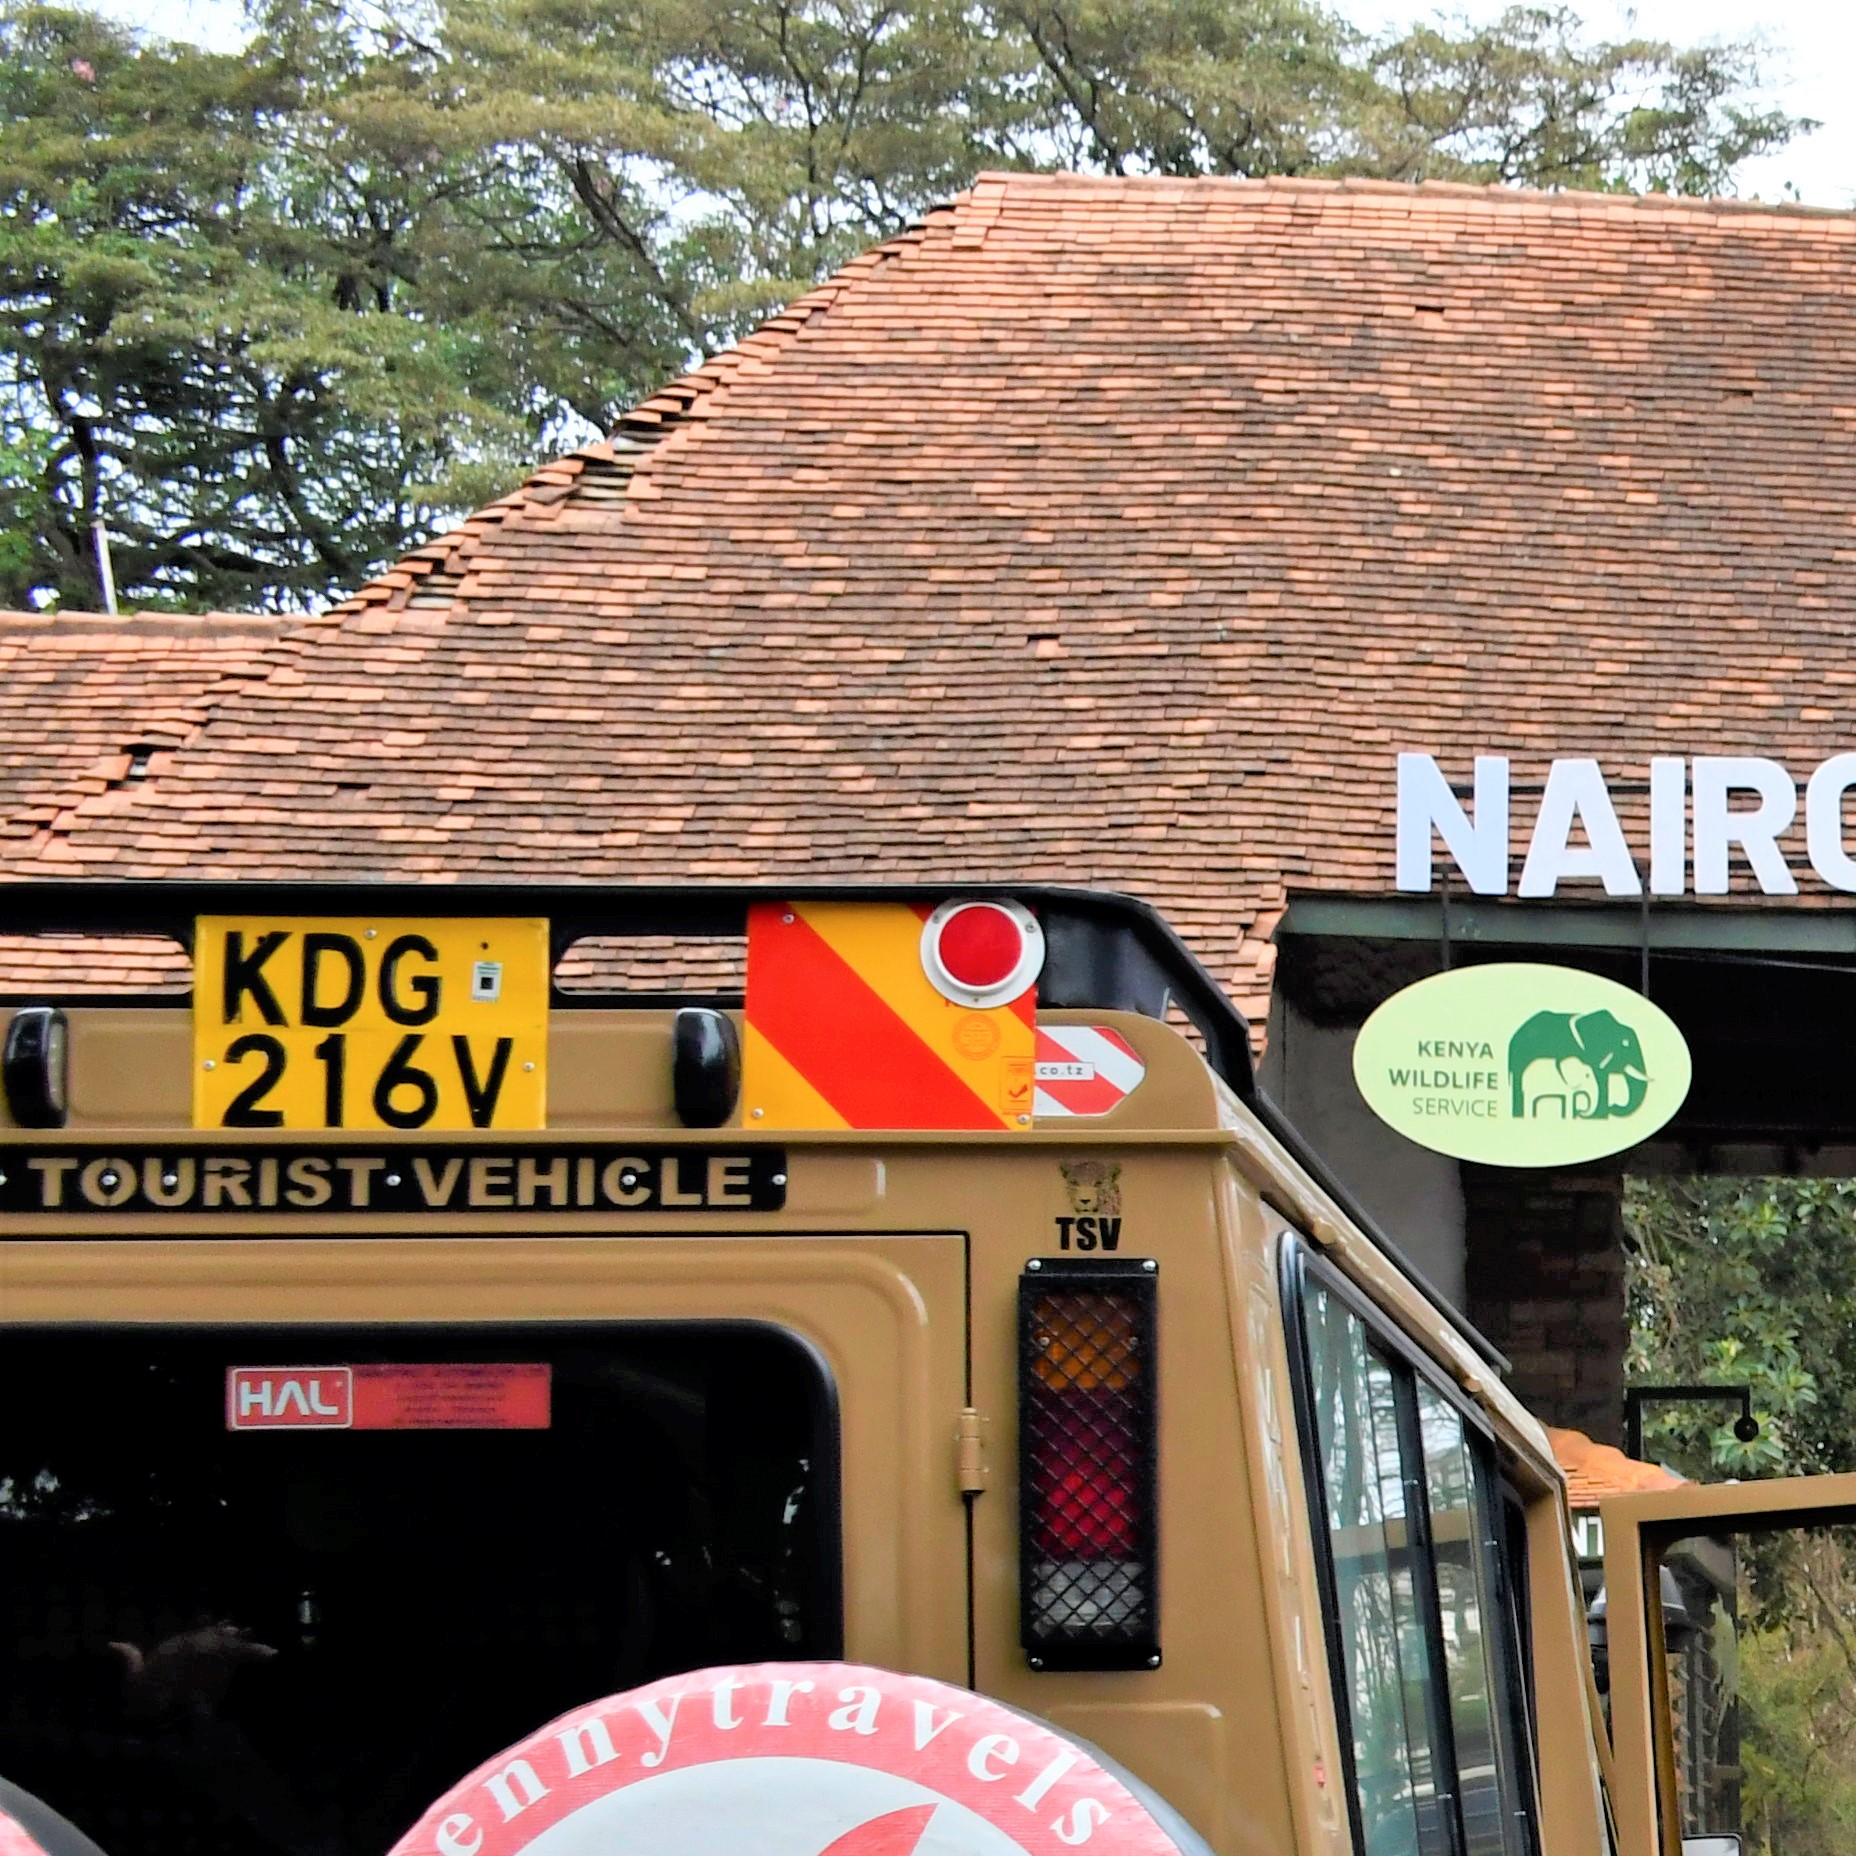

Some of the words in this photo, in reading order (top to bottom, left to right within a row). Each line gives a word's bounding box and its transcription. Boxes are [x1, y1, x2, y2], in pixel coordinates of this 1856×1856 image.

[223, 931, 442, 1027] KDG
[1417, 1040, 1495, 1060] KENYA
[222, 1033, 514, 1129] 216V
[1388, 1067, 1499, 1090] WILDLIFE
[1412, 1096, 1498, 1118] SERVICE
[27, 1157, 386, 1207] TOURIST
[411, 1157, 752, 1206] VEHICLE
[1055, 1217, 1122, 1251] TSV
[240, 1380, 339, 1416] HAL
